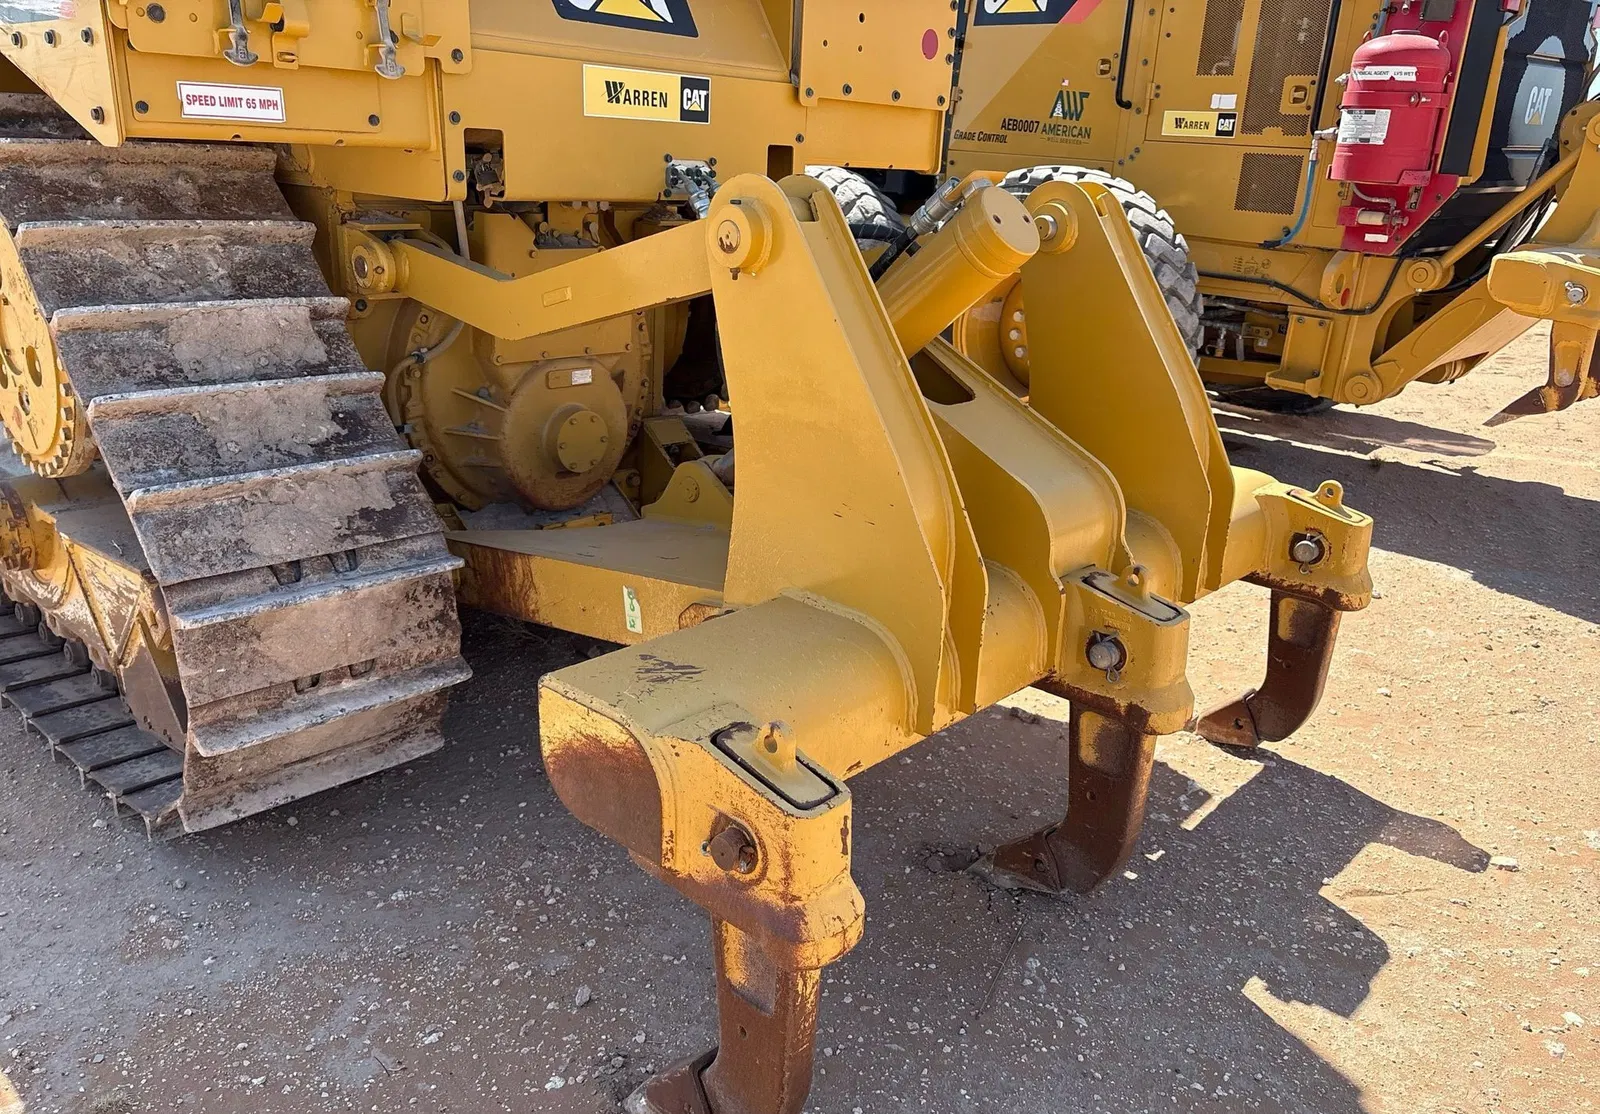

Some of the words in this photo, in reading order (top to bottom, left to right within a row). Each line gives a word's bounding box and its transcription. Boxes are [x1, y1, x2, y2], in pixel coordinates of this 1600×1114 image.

[186, 94, 216, 107] SPEED
[218, 96, 243, 109] LIMIT
[246, 98, 256, 110] 65
[259, 99, 279, 111] MPH
[604, 80, 668, 108] WARREN
[683, 88, 708, 111] CAT
[1525, 86, 1552, 125] CAT
[1001, 118, 1040, 133] AEB0007
[1041, 123, 1092, 140] AMERICAN
[1174, 117, 1210, 130] WARREN
[1217, 118, 1235, 131] CAT
[954, 129, 976, 141] GRADE
[977, 131, 1008, 144] CONTROL
